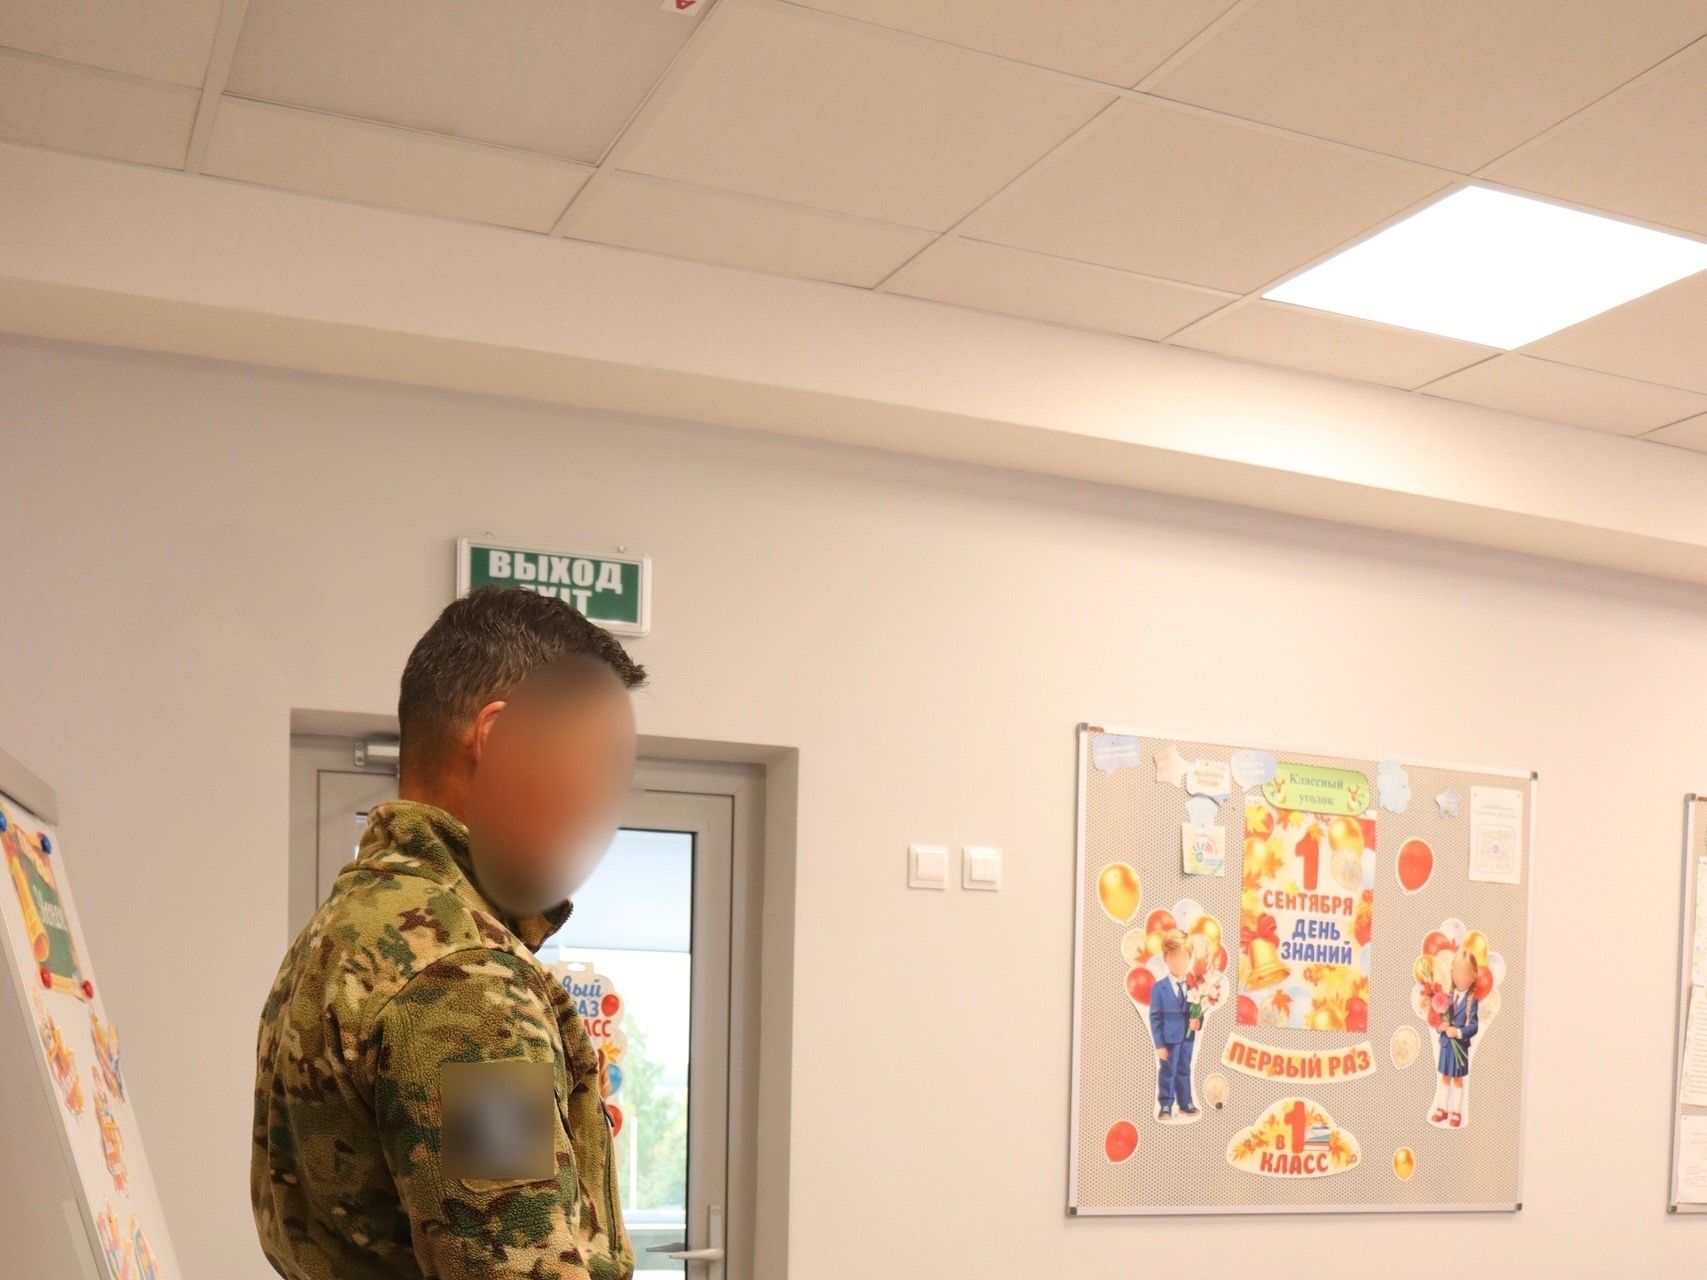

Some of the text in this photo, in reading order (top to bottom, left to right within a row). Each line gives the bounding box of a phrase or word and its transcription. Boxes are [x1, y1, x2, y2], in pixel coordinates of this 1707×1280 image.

[488, 550, 623, 595] ВЫХОД
[519, 584, 593, 617] IT
[1289, 773, 1344, 789] Классный
[1298, 794, 1335, 806] уголок
[1295, 831, 1320, 891] 1
[1262, 890, 1354, 916] СЕНТЯБРЯ
[1291, 918, 1341, 941] ДЕНЬ
[1281, 941, 1352, 966] ЗНАНИЙ
[573, 1000, 600, 1018] АЗ
[1228, 1041, 1371, 1079] ПЕРВЫЙ РАЗ
[1284, 1100, 1306, 1154] 1
[1259, 1151, 1329, 1175] КЛАСС
